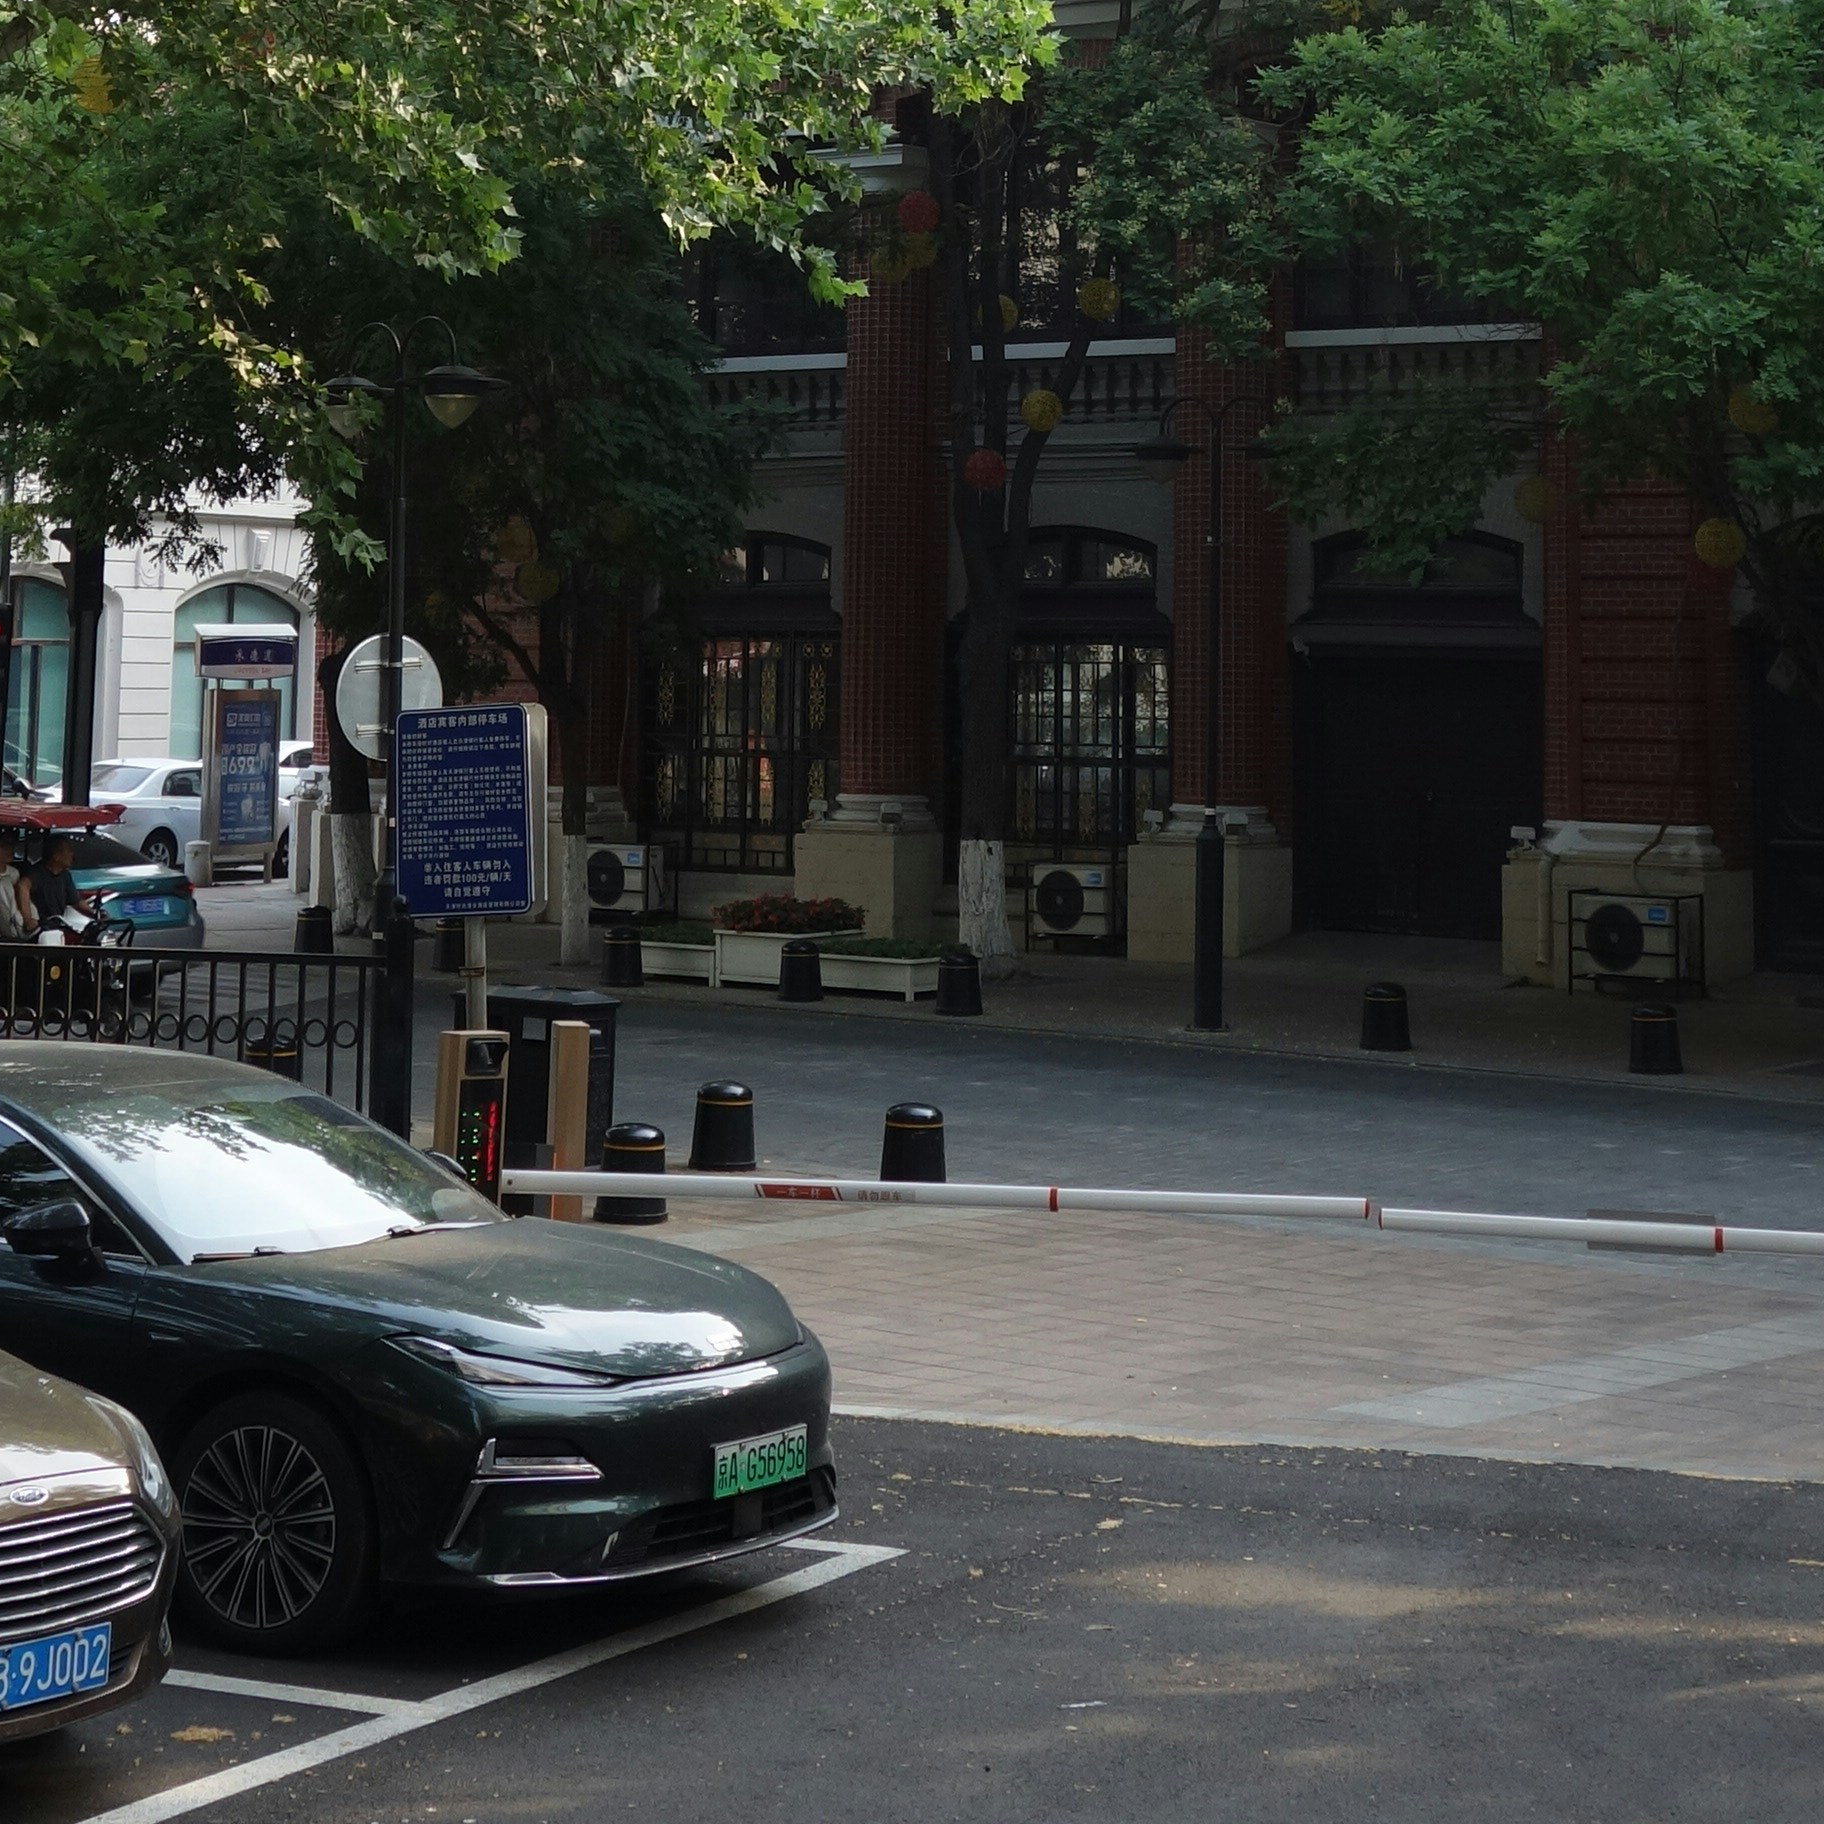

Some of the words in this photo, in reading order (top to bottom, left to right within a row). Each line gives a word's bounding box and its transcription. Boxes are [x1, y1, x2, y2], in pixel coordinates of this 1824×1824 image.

[417, 713, 508, 730] 酒店宾客内部停车场
